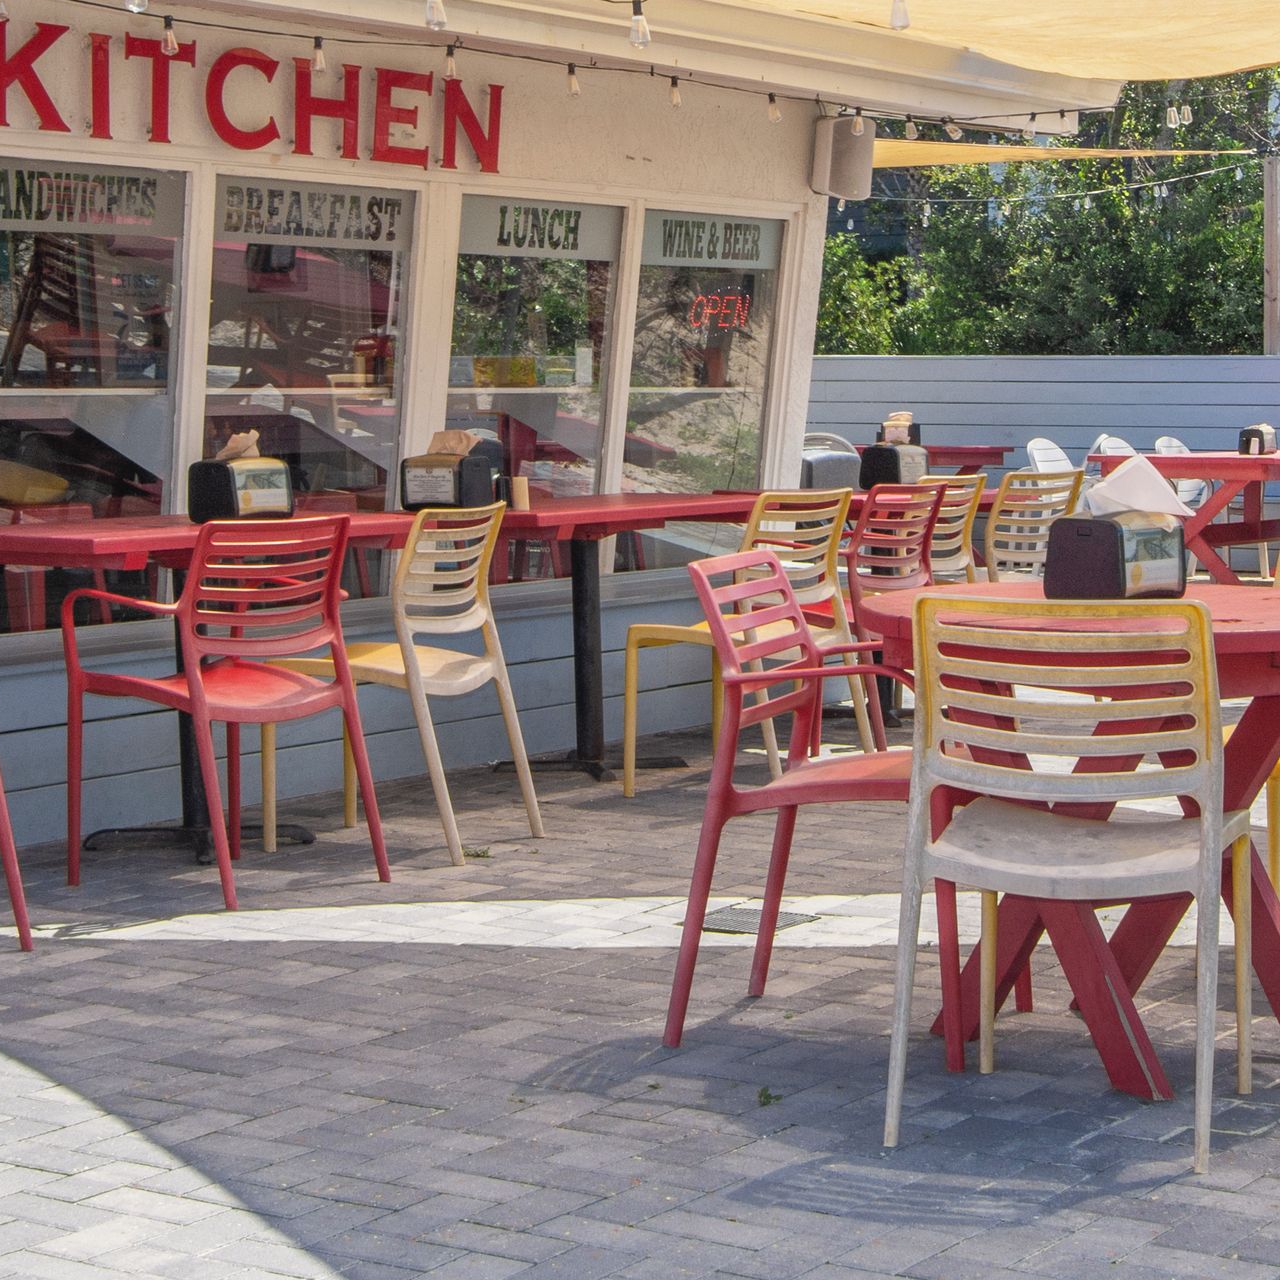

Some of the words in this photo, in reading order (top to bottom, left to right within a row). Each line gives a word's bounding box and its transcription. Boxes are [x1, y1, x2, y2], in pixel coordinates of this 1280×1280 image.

[224, 185, 402, 242] BREAKFAST
[496, 205, 581, 251] LUNCH
[662, 218, 705, 259] WINE
[706, 222, 720, 259] &
[721, 222, 761, 261] BEER
[689, 295, 751, 328] OPEN
